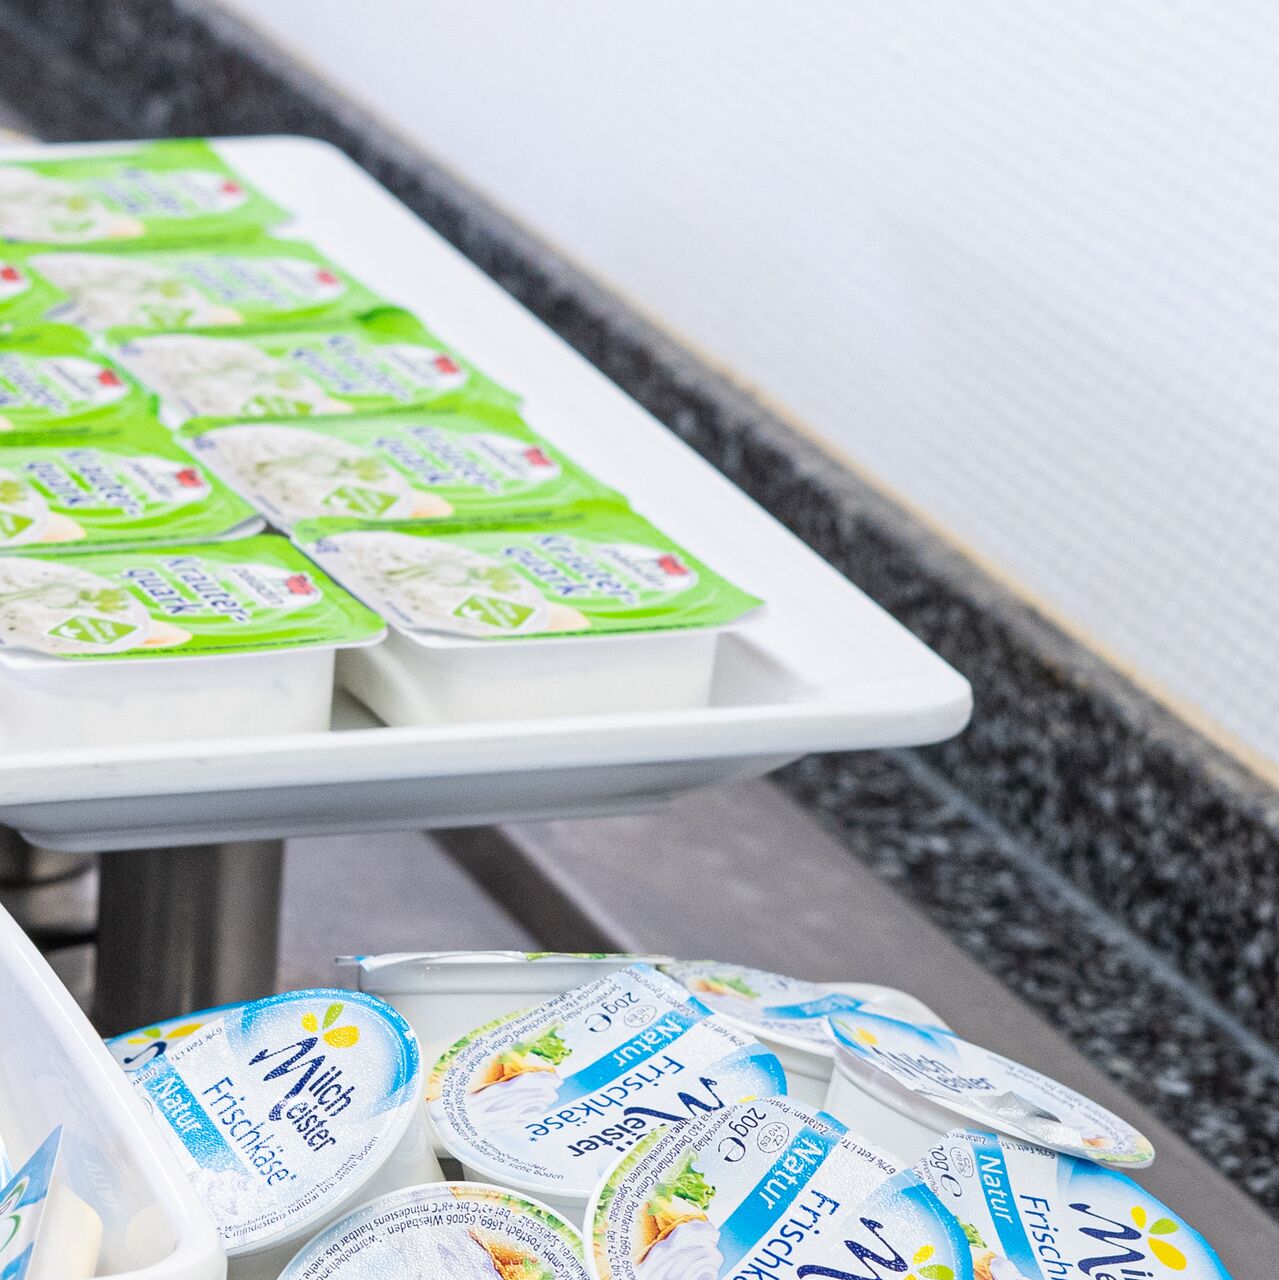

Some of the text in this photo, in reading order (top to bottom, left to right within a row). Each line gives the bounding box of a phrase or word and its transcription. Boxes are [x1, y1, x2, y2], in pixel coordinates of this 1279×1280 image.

[601, 991, 640, 1015] 20g
[617, 1023, 684, 1068] Natur
[248, 1036, 356, 1122] Milch
[155, 1077, 206, 1134] Natur
[728, 1107, 767, 1138] 20g
[757, 1137, 826, 1210] Natur
[977, 1153, 1014, 1225] Natur
[373, 1203, 430, 1228] mindestens
[386, 1214, 443, 1235] Wiesbaden
[340, 1222, 375, 1245] haltbar
[505, 1222, 543, 1252] Postfach
